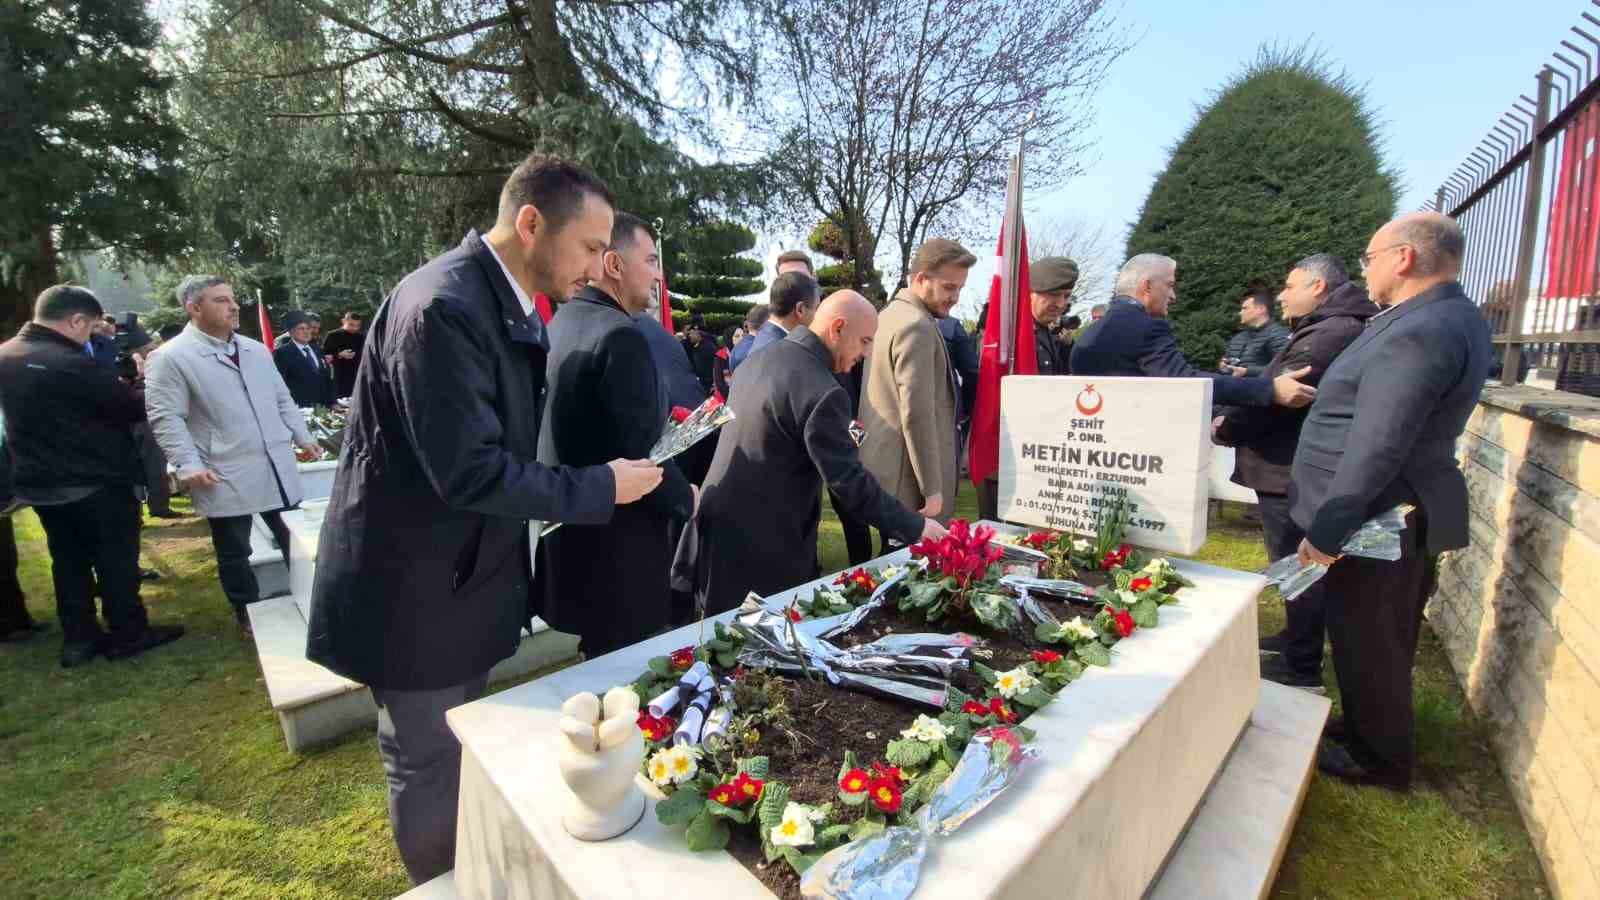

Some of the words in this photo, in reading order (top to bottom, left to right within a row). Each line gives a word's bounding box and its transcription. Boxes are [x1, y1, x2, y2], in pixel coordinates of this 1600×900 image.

[1071, 417, 1104, 430] ŞEHİT
[1067, 431, 1076, 441] P.
[1080, 432, 1107, 444] ONB.
[1022, 443, 1081, 465] METİN
[1087, 449, 1164, 474] KUCUR
[1034, 464, 1088, 478] MEMLEKETİ
[1096, 472, 1147, 486] ERZURUM
[1076, 482, 1094, 493] ADI
[1066, 494, 1083, 505] ADI
